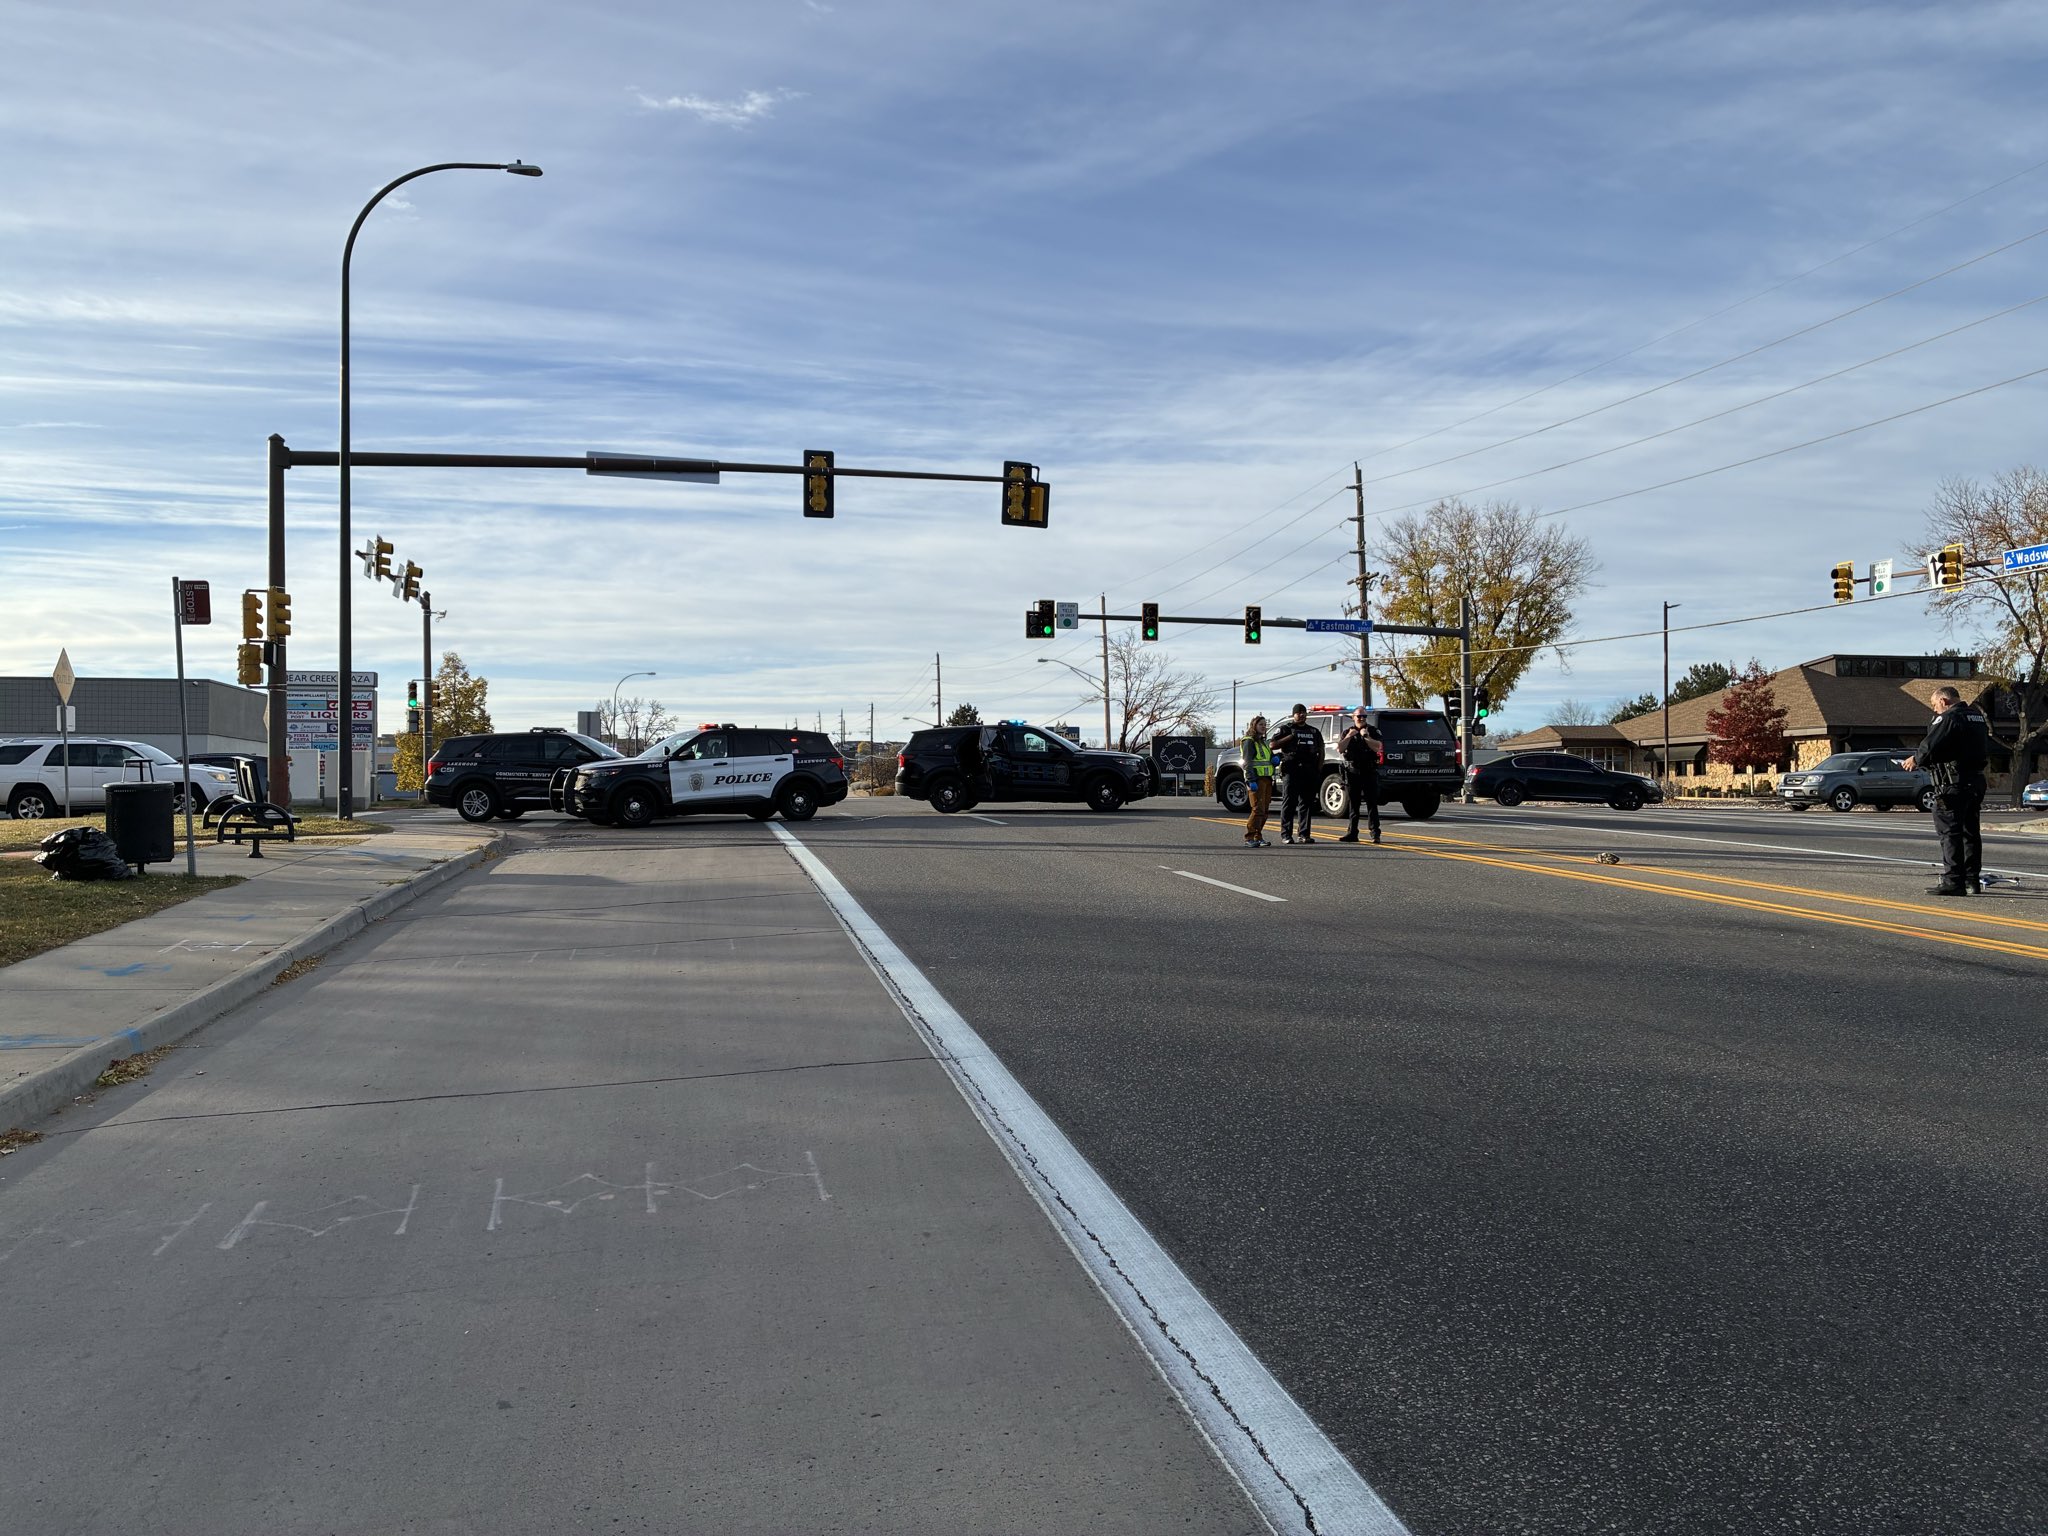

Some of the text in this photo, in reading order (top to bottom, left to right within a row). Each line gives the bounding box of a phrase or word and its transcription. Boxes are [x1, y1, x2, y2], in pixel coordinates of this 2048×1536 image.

[186, 590, 195, 613] STOP
[1320, 621, 1355, 630] Eastman
[713, 773, 773, 786] POLICE
